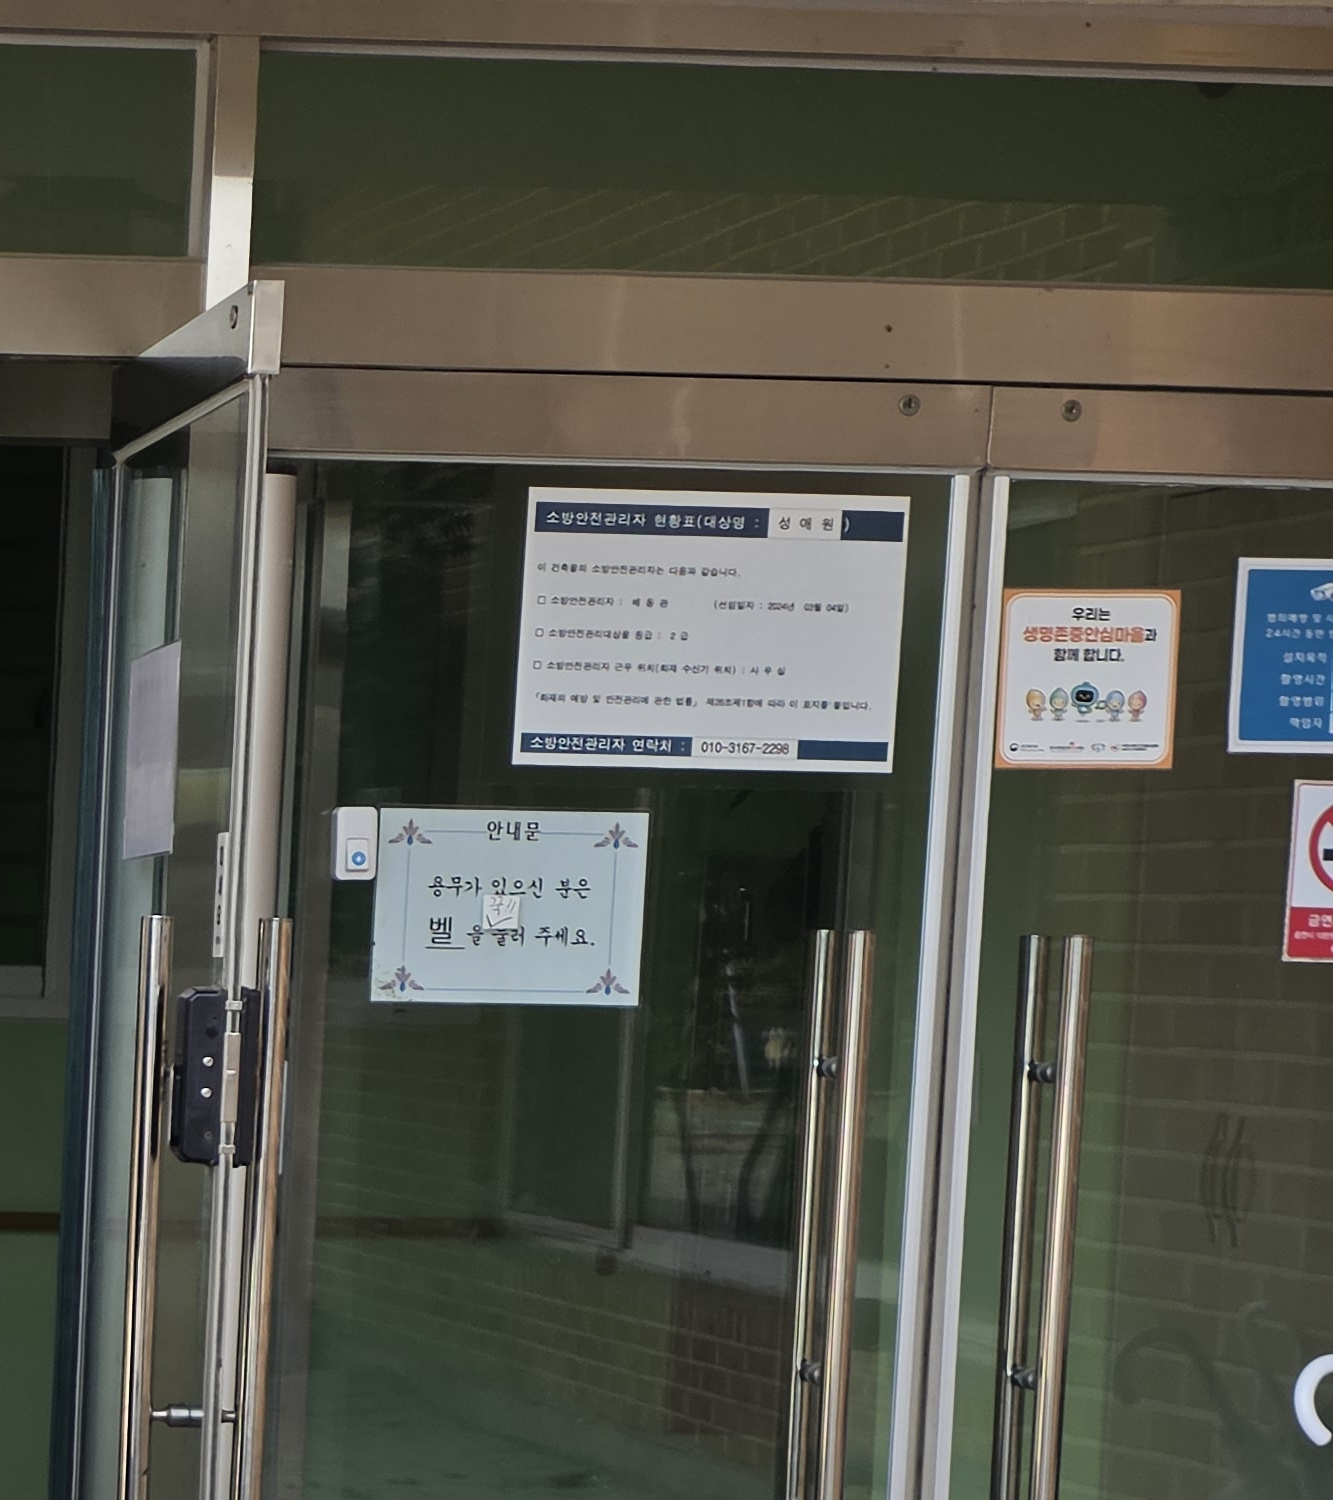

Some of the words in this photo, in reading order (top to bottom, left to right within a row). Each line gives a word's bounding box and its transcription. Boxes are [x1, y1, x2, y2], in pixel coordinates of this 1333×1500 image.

[546, 511, 646, 527] 소방안전관리자
[1072, 607, 1111, 621] 우리는
[1054, 648, 1079, 662] 함께
[1083, 648, 1125, 662] 합니다.
[530, 736, 626, 751] 소방안전관리자
[633, 738, 672, 752] 연락처
[701, 741, 790, 755] 010-3167-2298
[486, 820, 540, 841] 안내문
[428, 875, 482, 898] 용무가
[491, 878, 543, 898] 있으신
[555, 878, 592, 898] 분은
[429, 916, 453, 944] 벨
[534, 927, 596, 948] 주세요.
